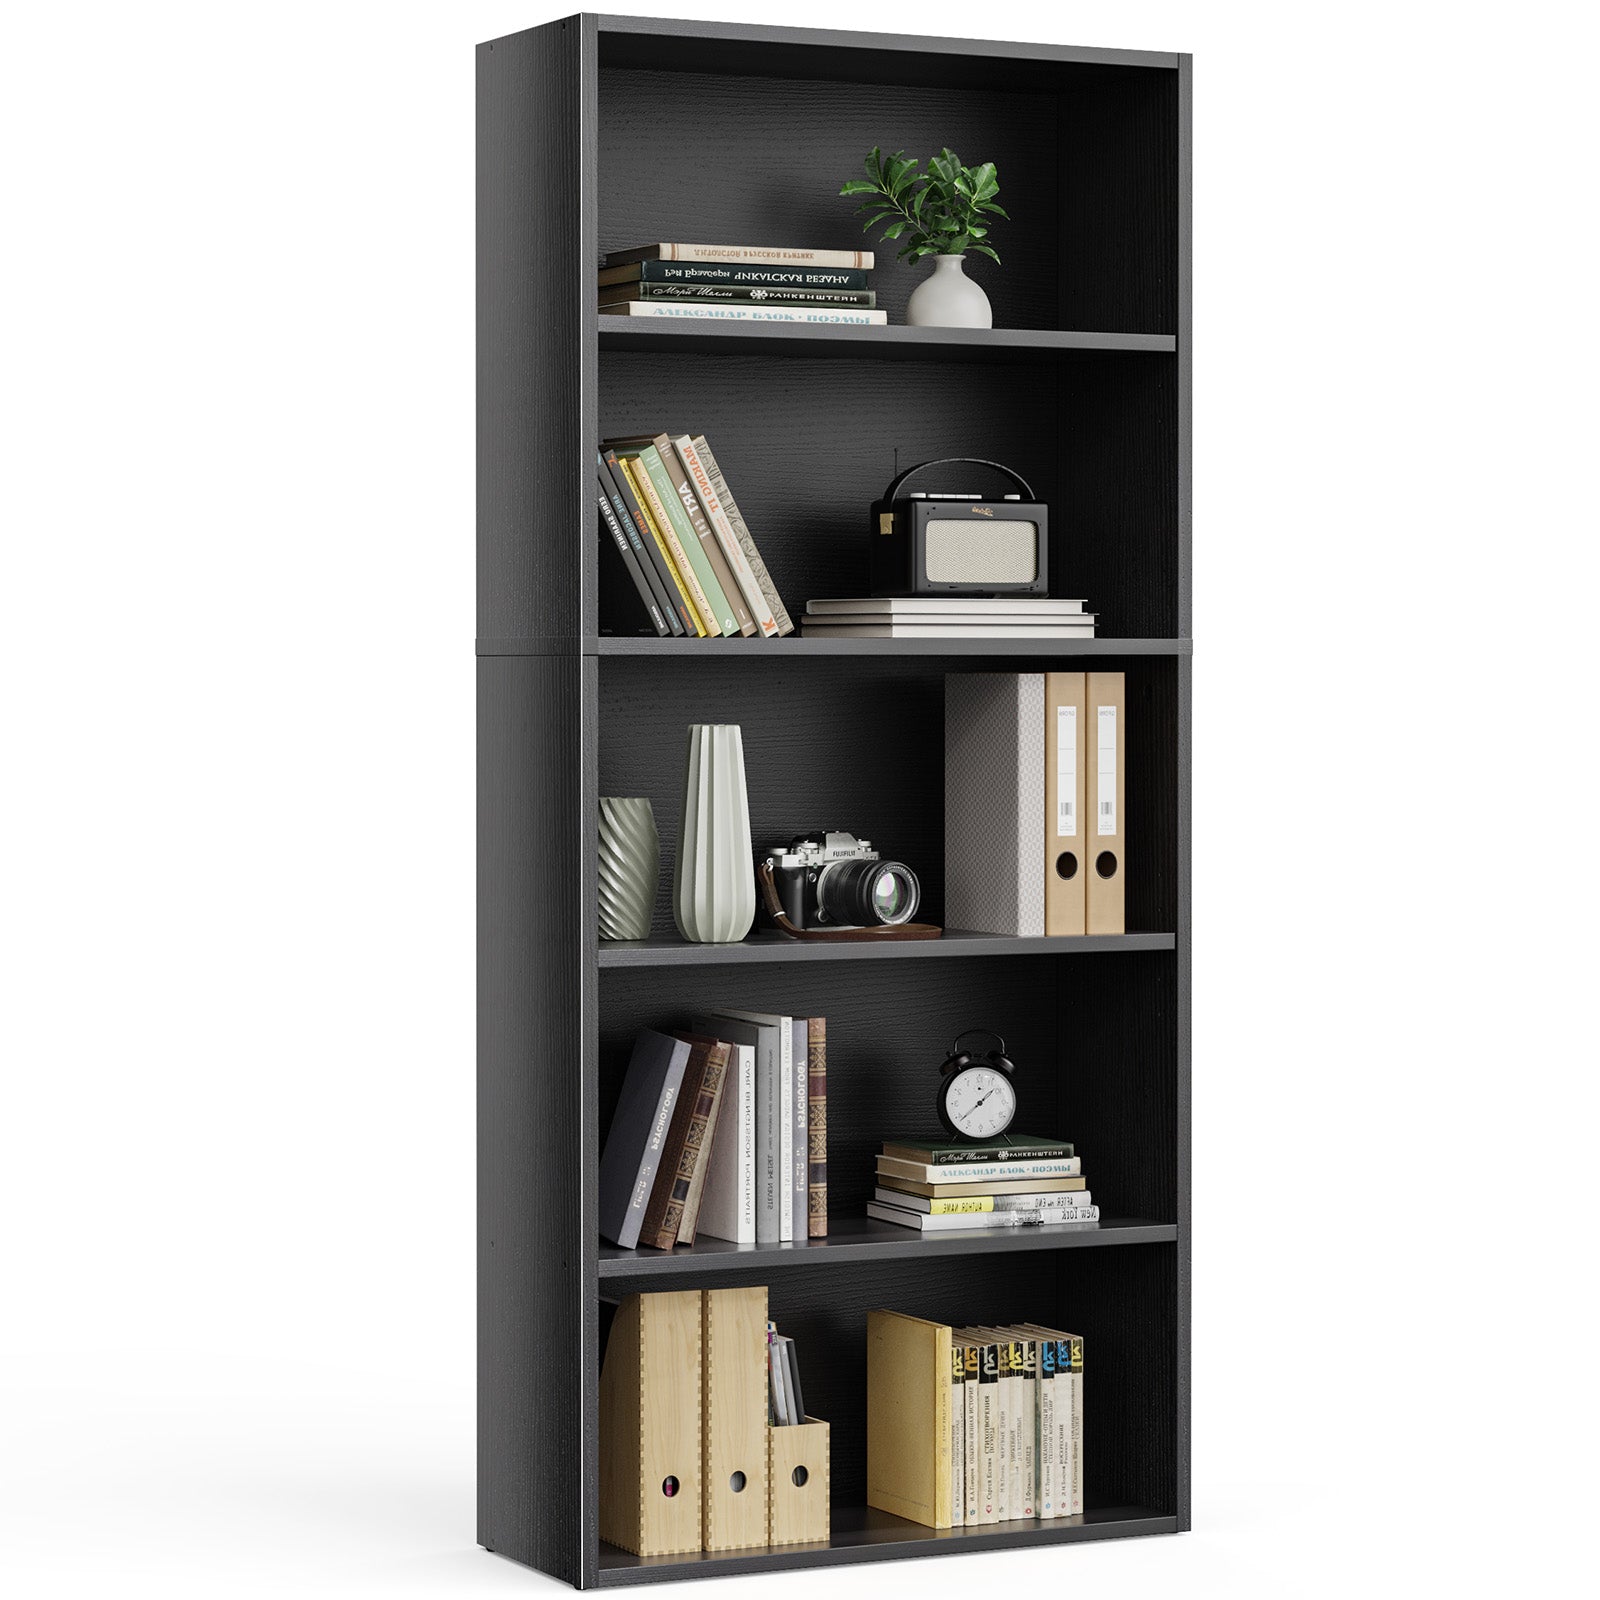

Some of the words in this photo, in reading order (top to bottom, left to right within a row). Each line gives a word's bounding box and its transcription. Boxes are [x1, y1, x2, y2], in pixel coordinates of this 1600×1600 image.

[752, 312, 796, 321] БЛОК
[806, 313, 871, 325] ПОЭМЫ
[1000, 1167, 1026, 1175] БЛОК
[1032, 1165, 1071, 1173] ПОЭМЫ
